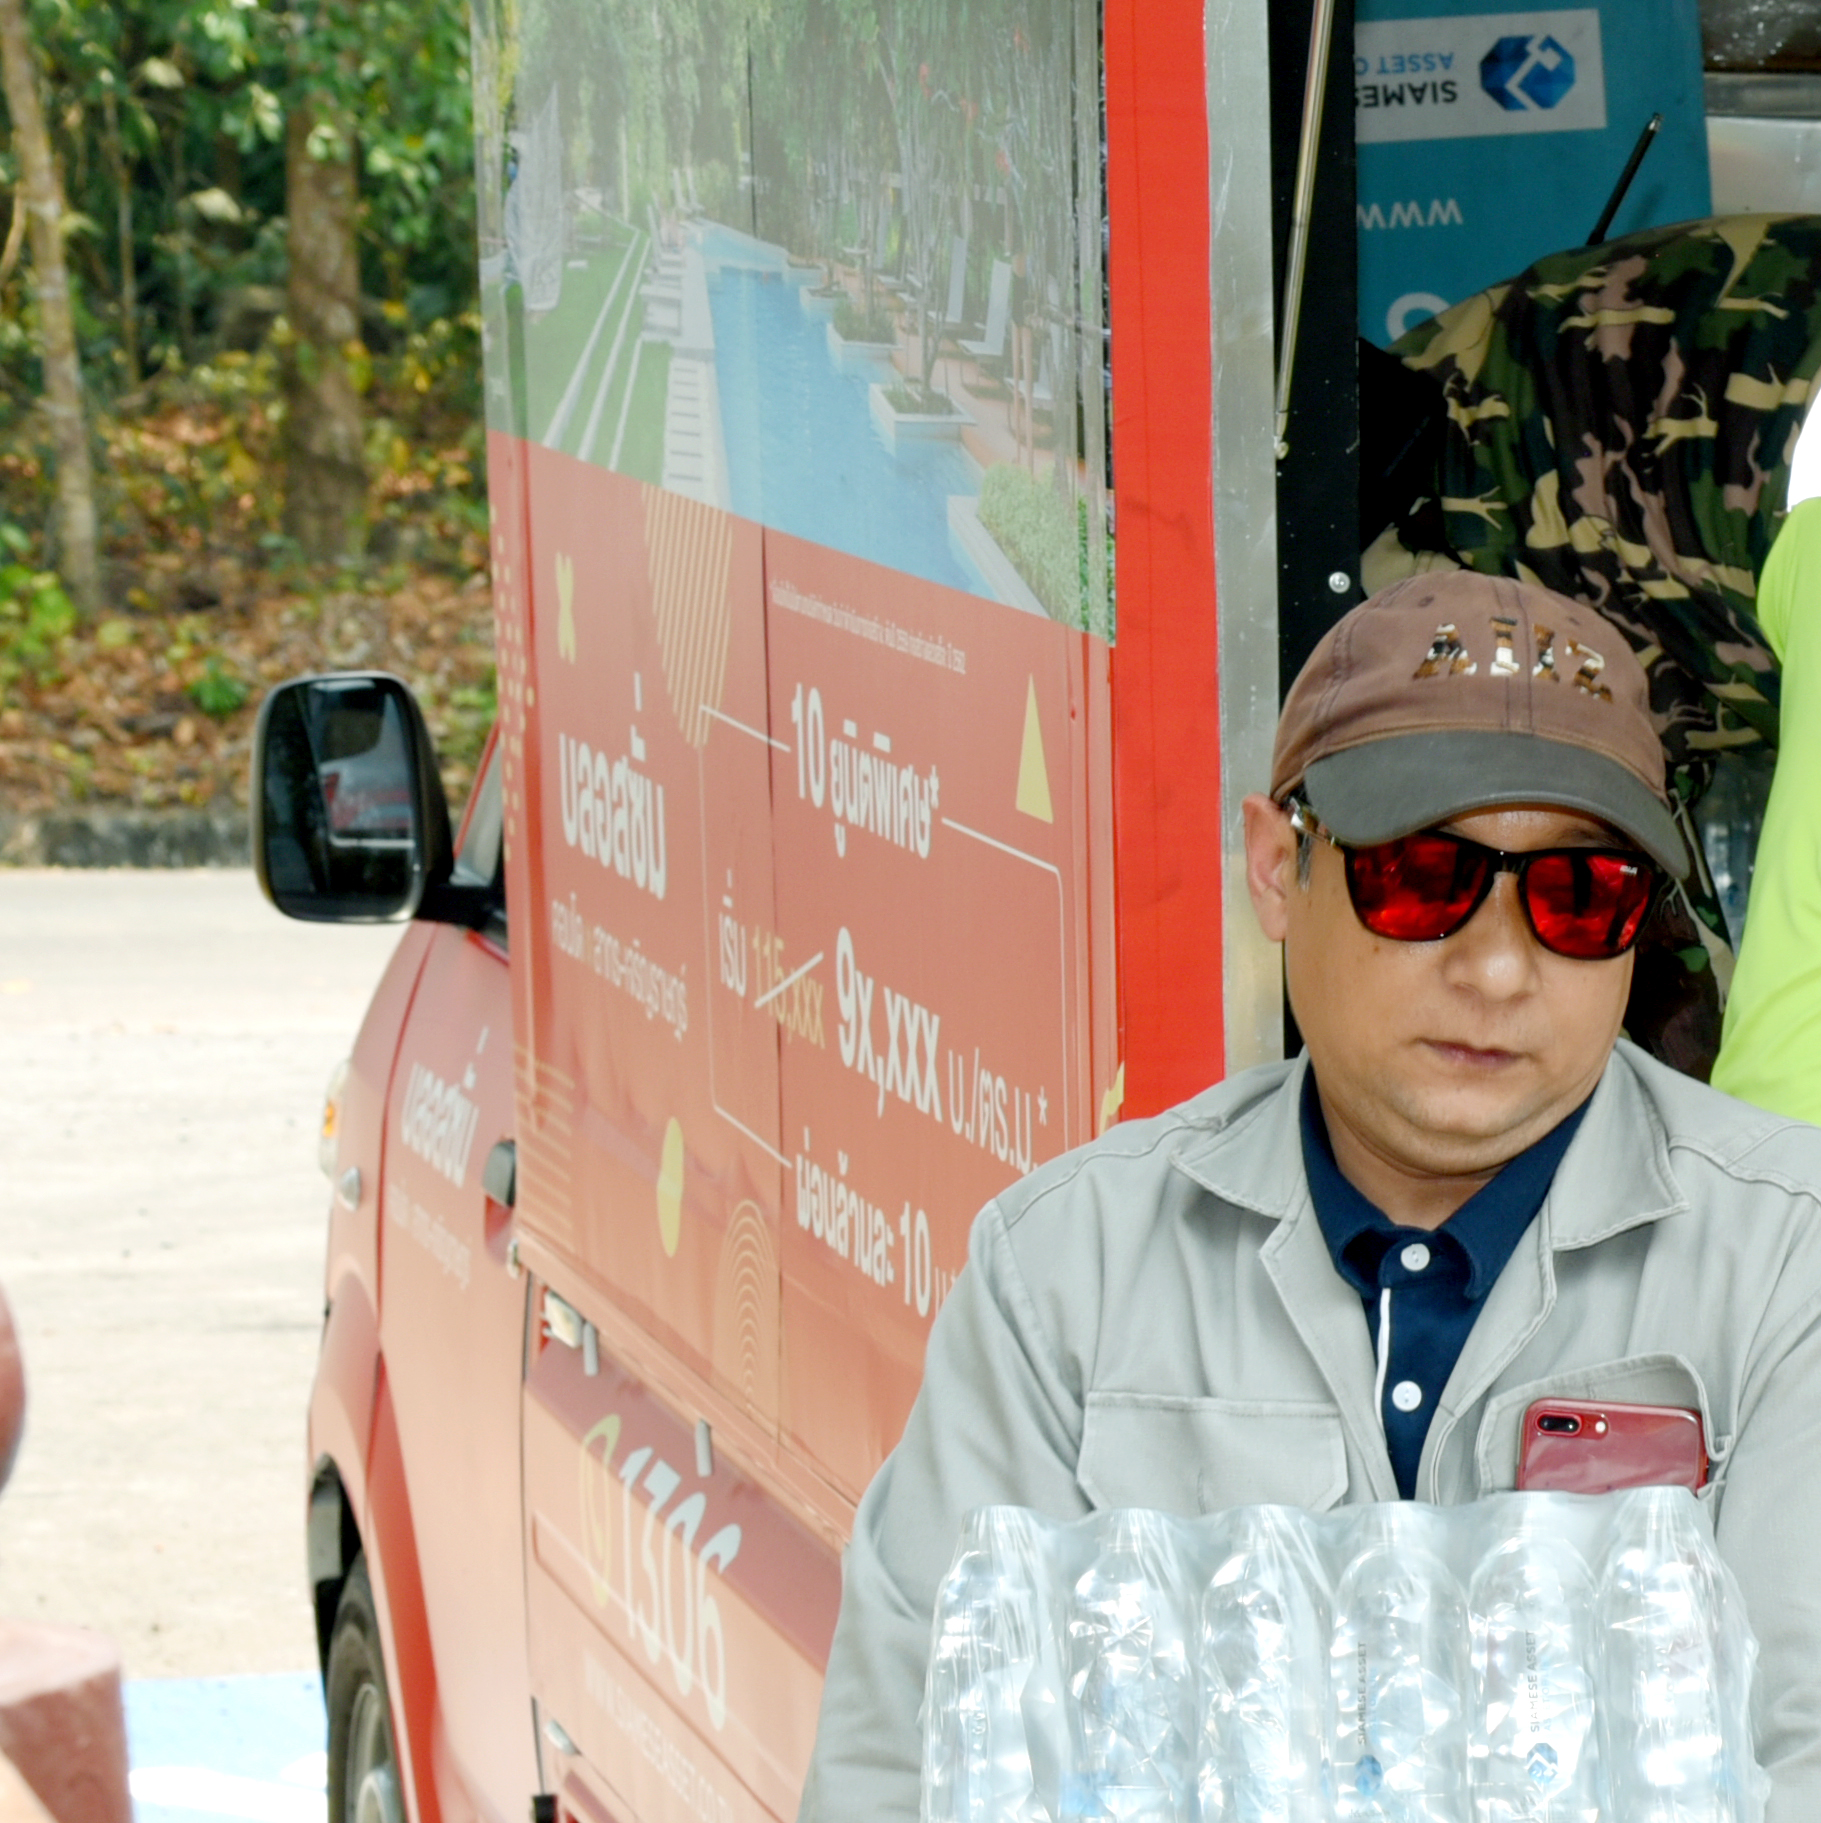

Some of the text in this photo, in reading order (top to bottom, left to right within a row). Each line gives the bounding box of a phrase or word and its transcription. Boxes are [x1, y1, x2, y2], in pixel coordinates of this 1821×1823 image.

[1377, 51, 1455, 75] ASSET
[790, 681, 826, 810] 10
[900, 1201, 933, 1319] 10
